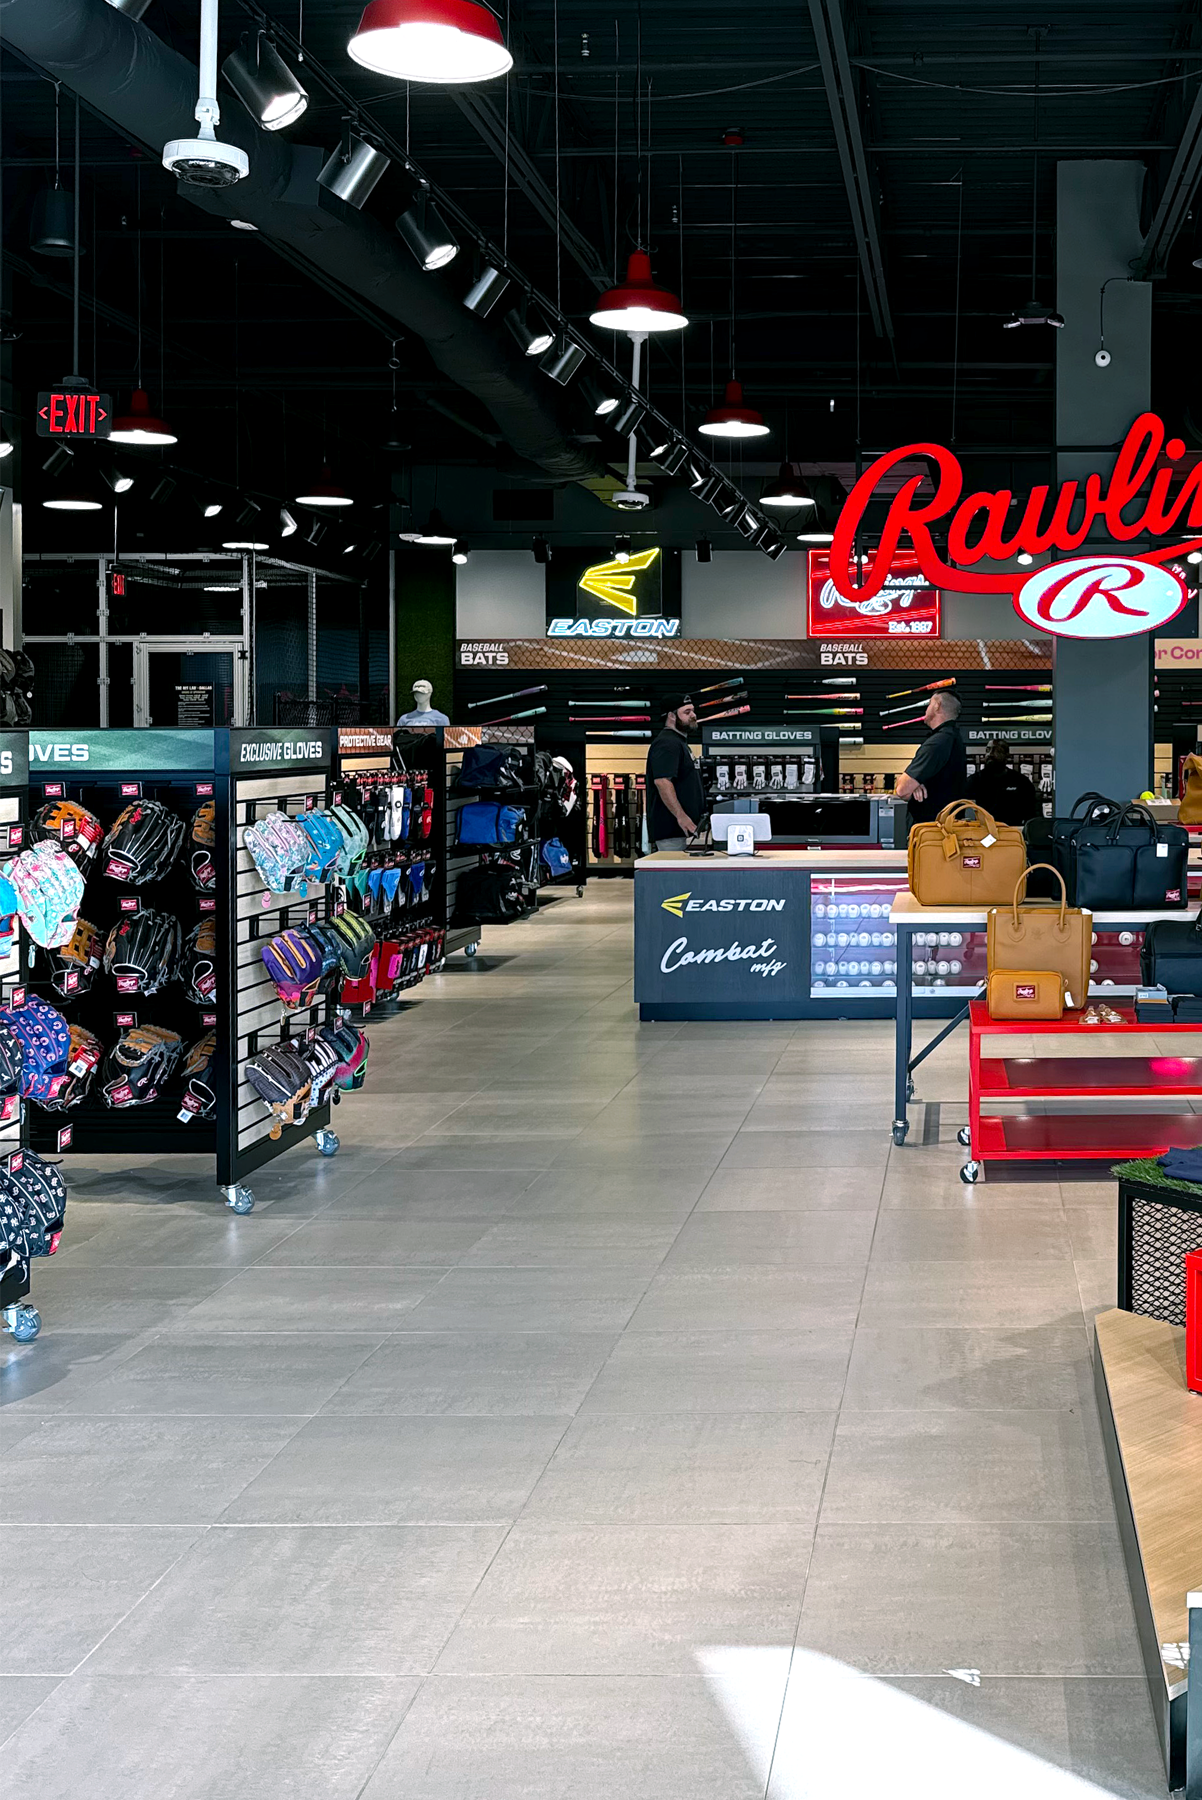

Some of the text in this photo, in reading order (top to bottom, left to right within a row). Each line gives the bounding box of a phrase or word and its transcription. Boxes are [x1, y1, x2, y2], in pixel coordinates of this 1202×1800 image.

[50, 395, 99, 433] EXIT
[547, 618, 680, 637] EASTON
[460, 643, 505, 652] BASEBALL
[820, 643, 863, 652] BASEBALL
[460, 652, 509, 665] BATS
[820, 652, 869, 665] BATS
[1154, 649, 1168, 660] r
[339, 734, 392, 748] PROTECTIVE GEAR
[712, 731, 812, 740] BATTING GLOVES
[968, 730, 1018, 739] BATTING
[240, 741, 323, 762] EXCLUSIVE GLOVES
[685, 899, 786, 912] EASTON
[660, 936, 778, 974] Combat
[750, 959, 787, 977] mfg
